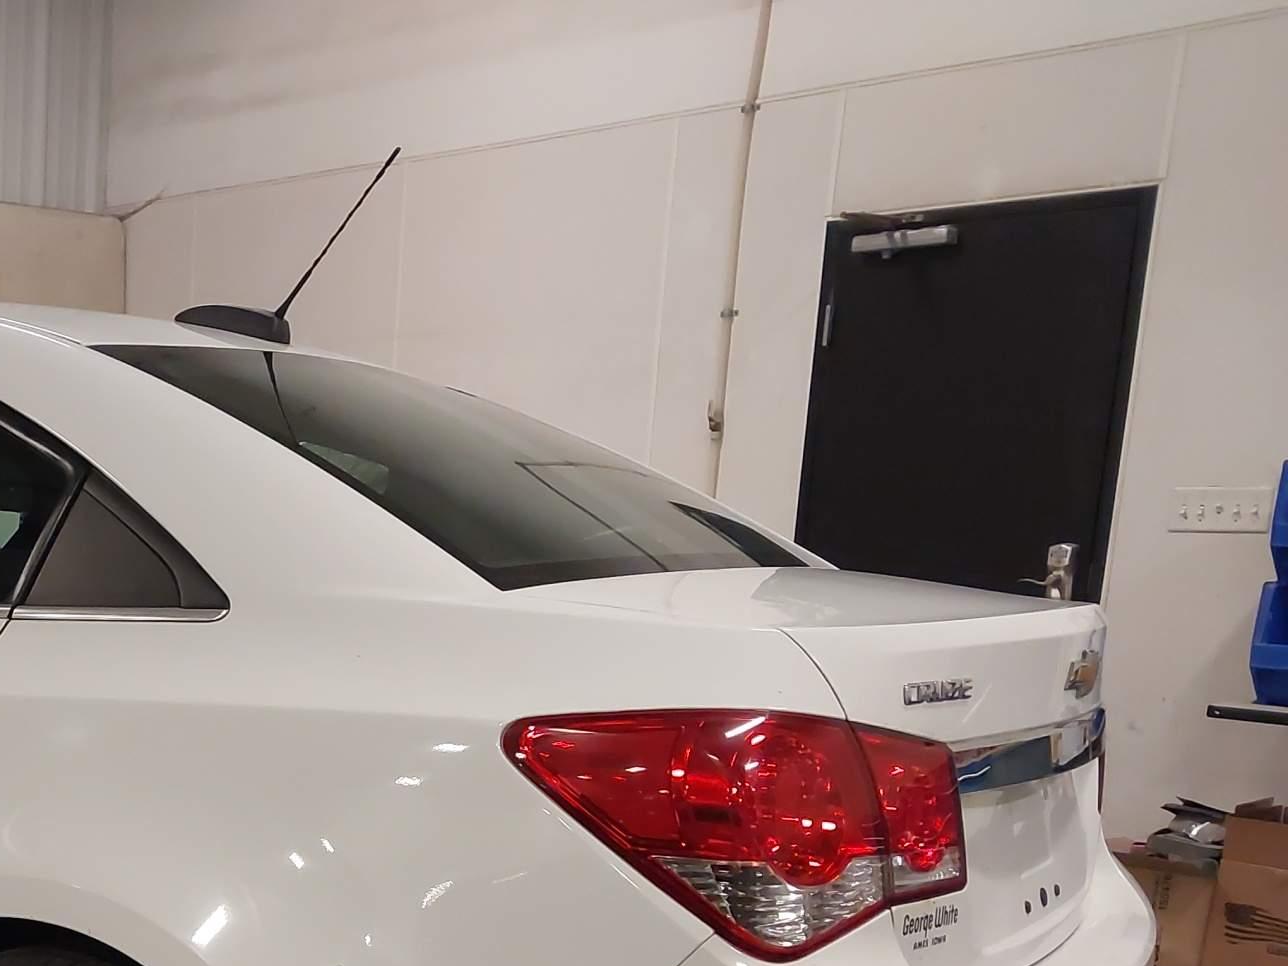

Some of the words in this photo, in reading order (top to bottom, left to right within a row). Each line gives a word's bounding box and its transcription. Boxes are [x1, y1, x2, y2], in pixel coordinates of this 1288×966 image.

[903, 679, 973, 706] CRUZE
[902, 914, 933, 938] George
[934, 904, 959, 928] White
